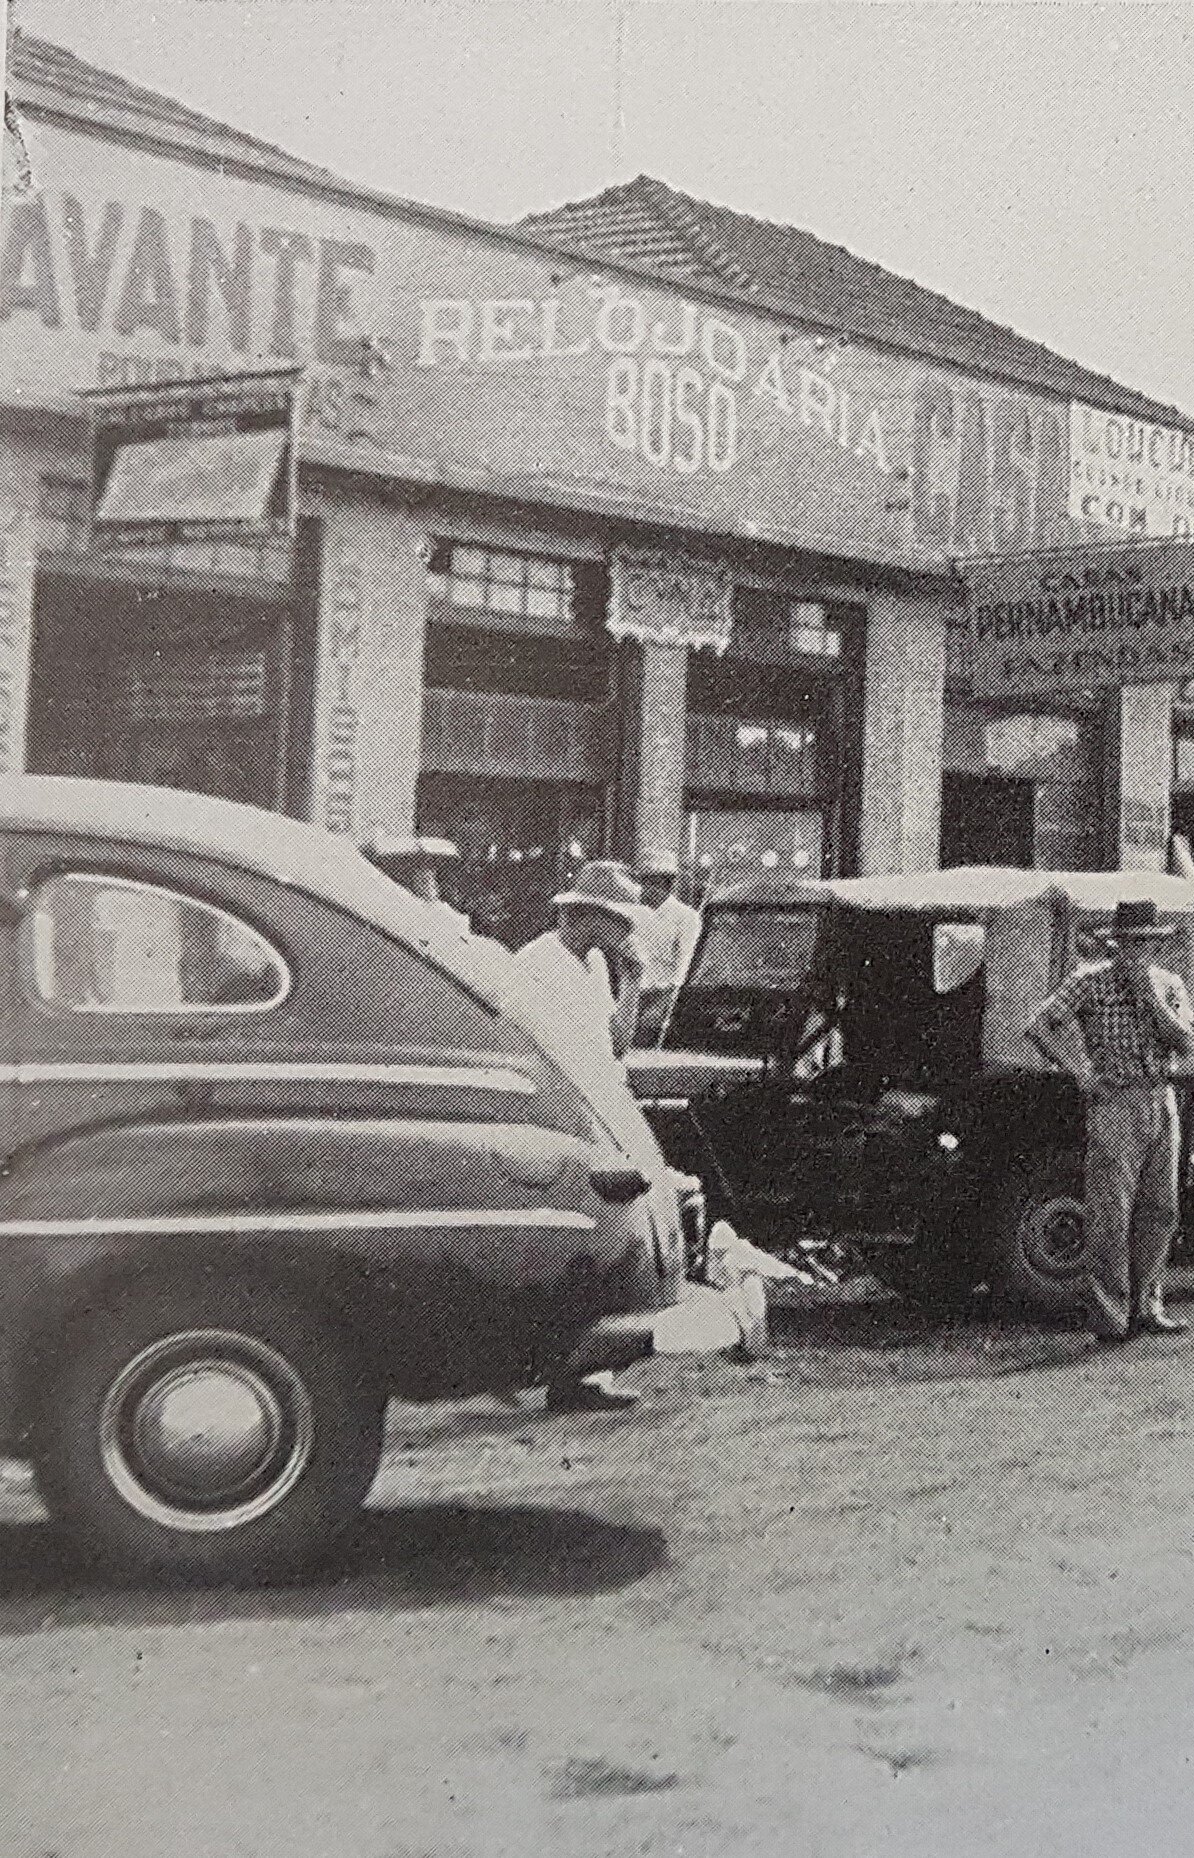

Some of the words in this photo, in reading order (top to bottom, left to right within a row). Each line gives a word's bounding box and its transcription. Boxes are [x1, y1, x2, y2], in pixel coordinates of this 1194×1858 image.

[0, 188, 396, 370] AVANTE
[416, 297, 892, 474] RELOJOARIA
[605, 357, 738, 475] BOSO
[1082, 494, 1147, 531] COM
[1040, 565, 1144, 592] CASAS
[1003, 642, 1192, 679] FAZENDAS
